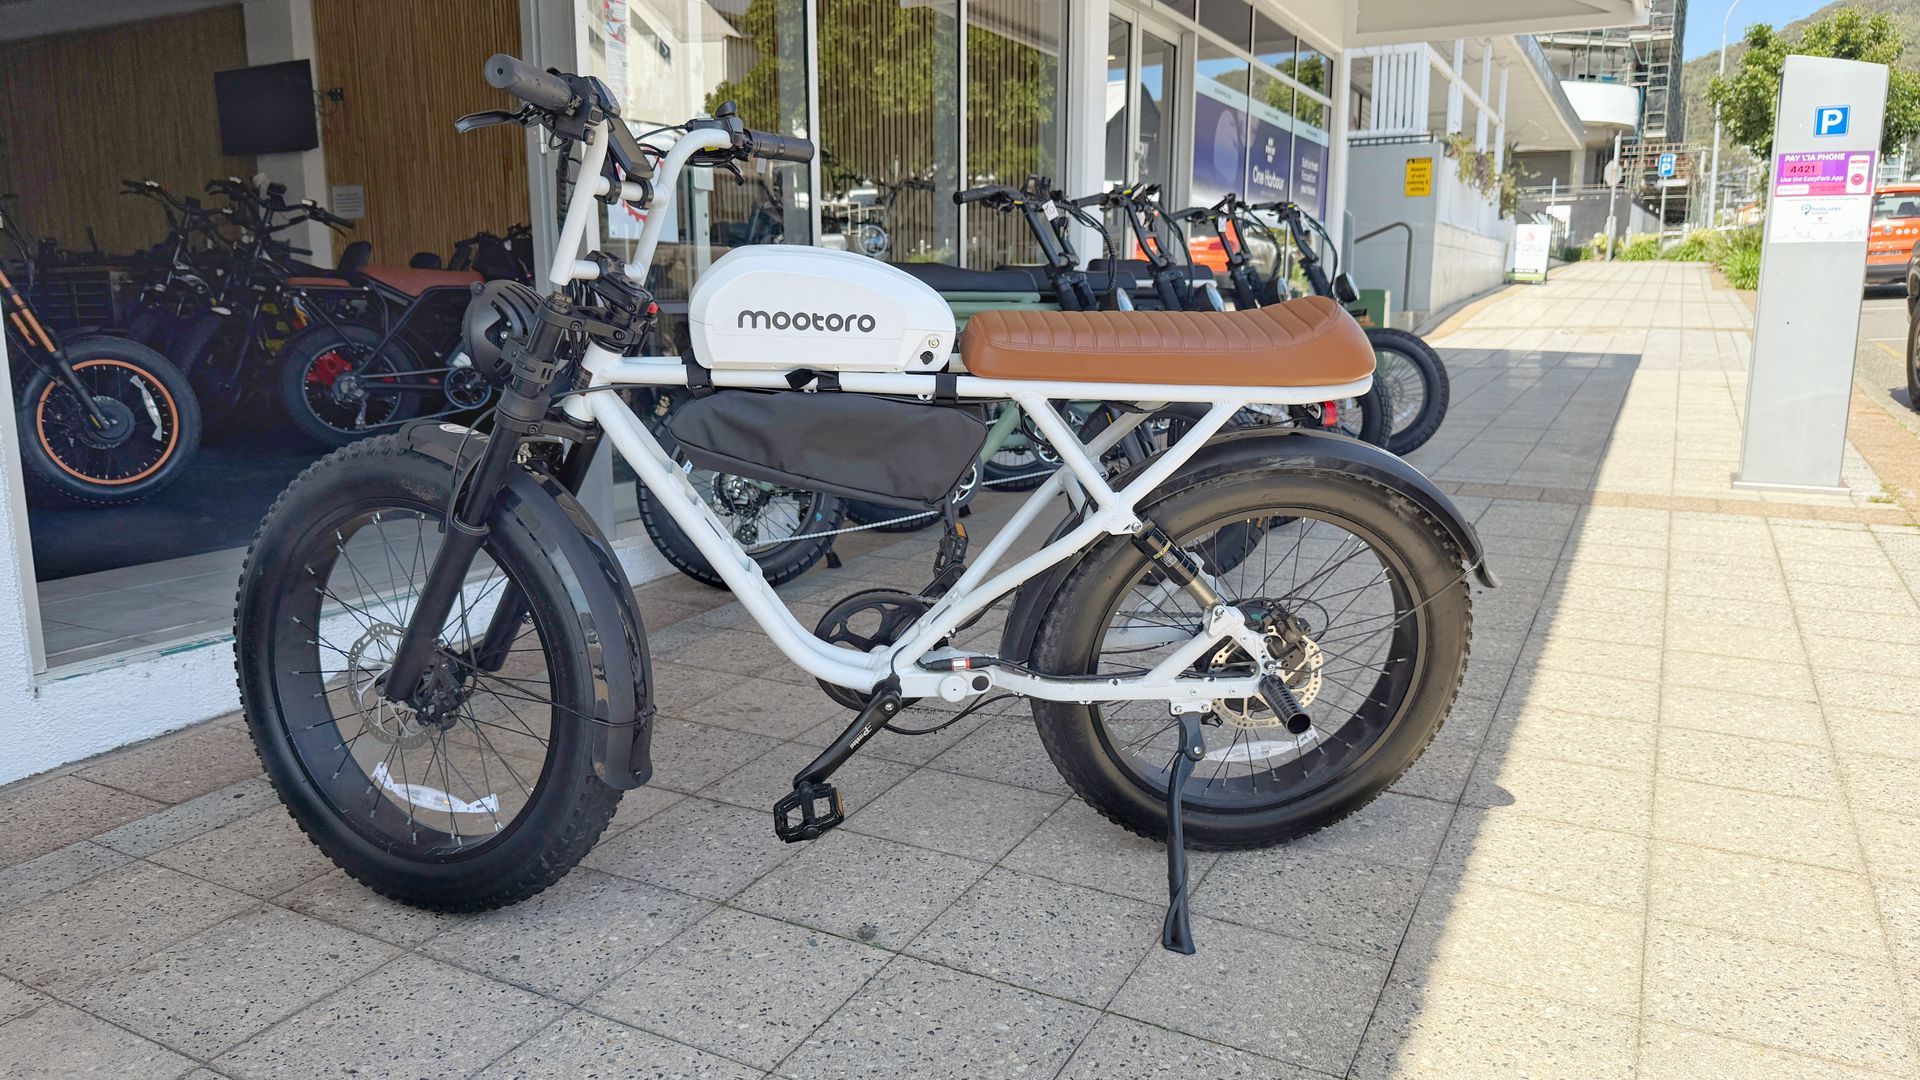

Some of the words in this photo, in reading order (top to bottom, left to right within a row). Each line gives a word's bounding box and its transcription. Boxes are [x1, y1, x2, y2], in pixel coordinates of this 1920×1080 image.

[1821, 109, 1843, 134] P
[1785, 154, 1801, 162] PAY
[1817, 152, 1846, 161] PHONE
[1790, 165, 1815, 173] 4421
[1252, 165, 1264, 184] One
[1264, 168, 1285, 191] Harbour
[737, 309, 876, 333] mootoro
